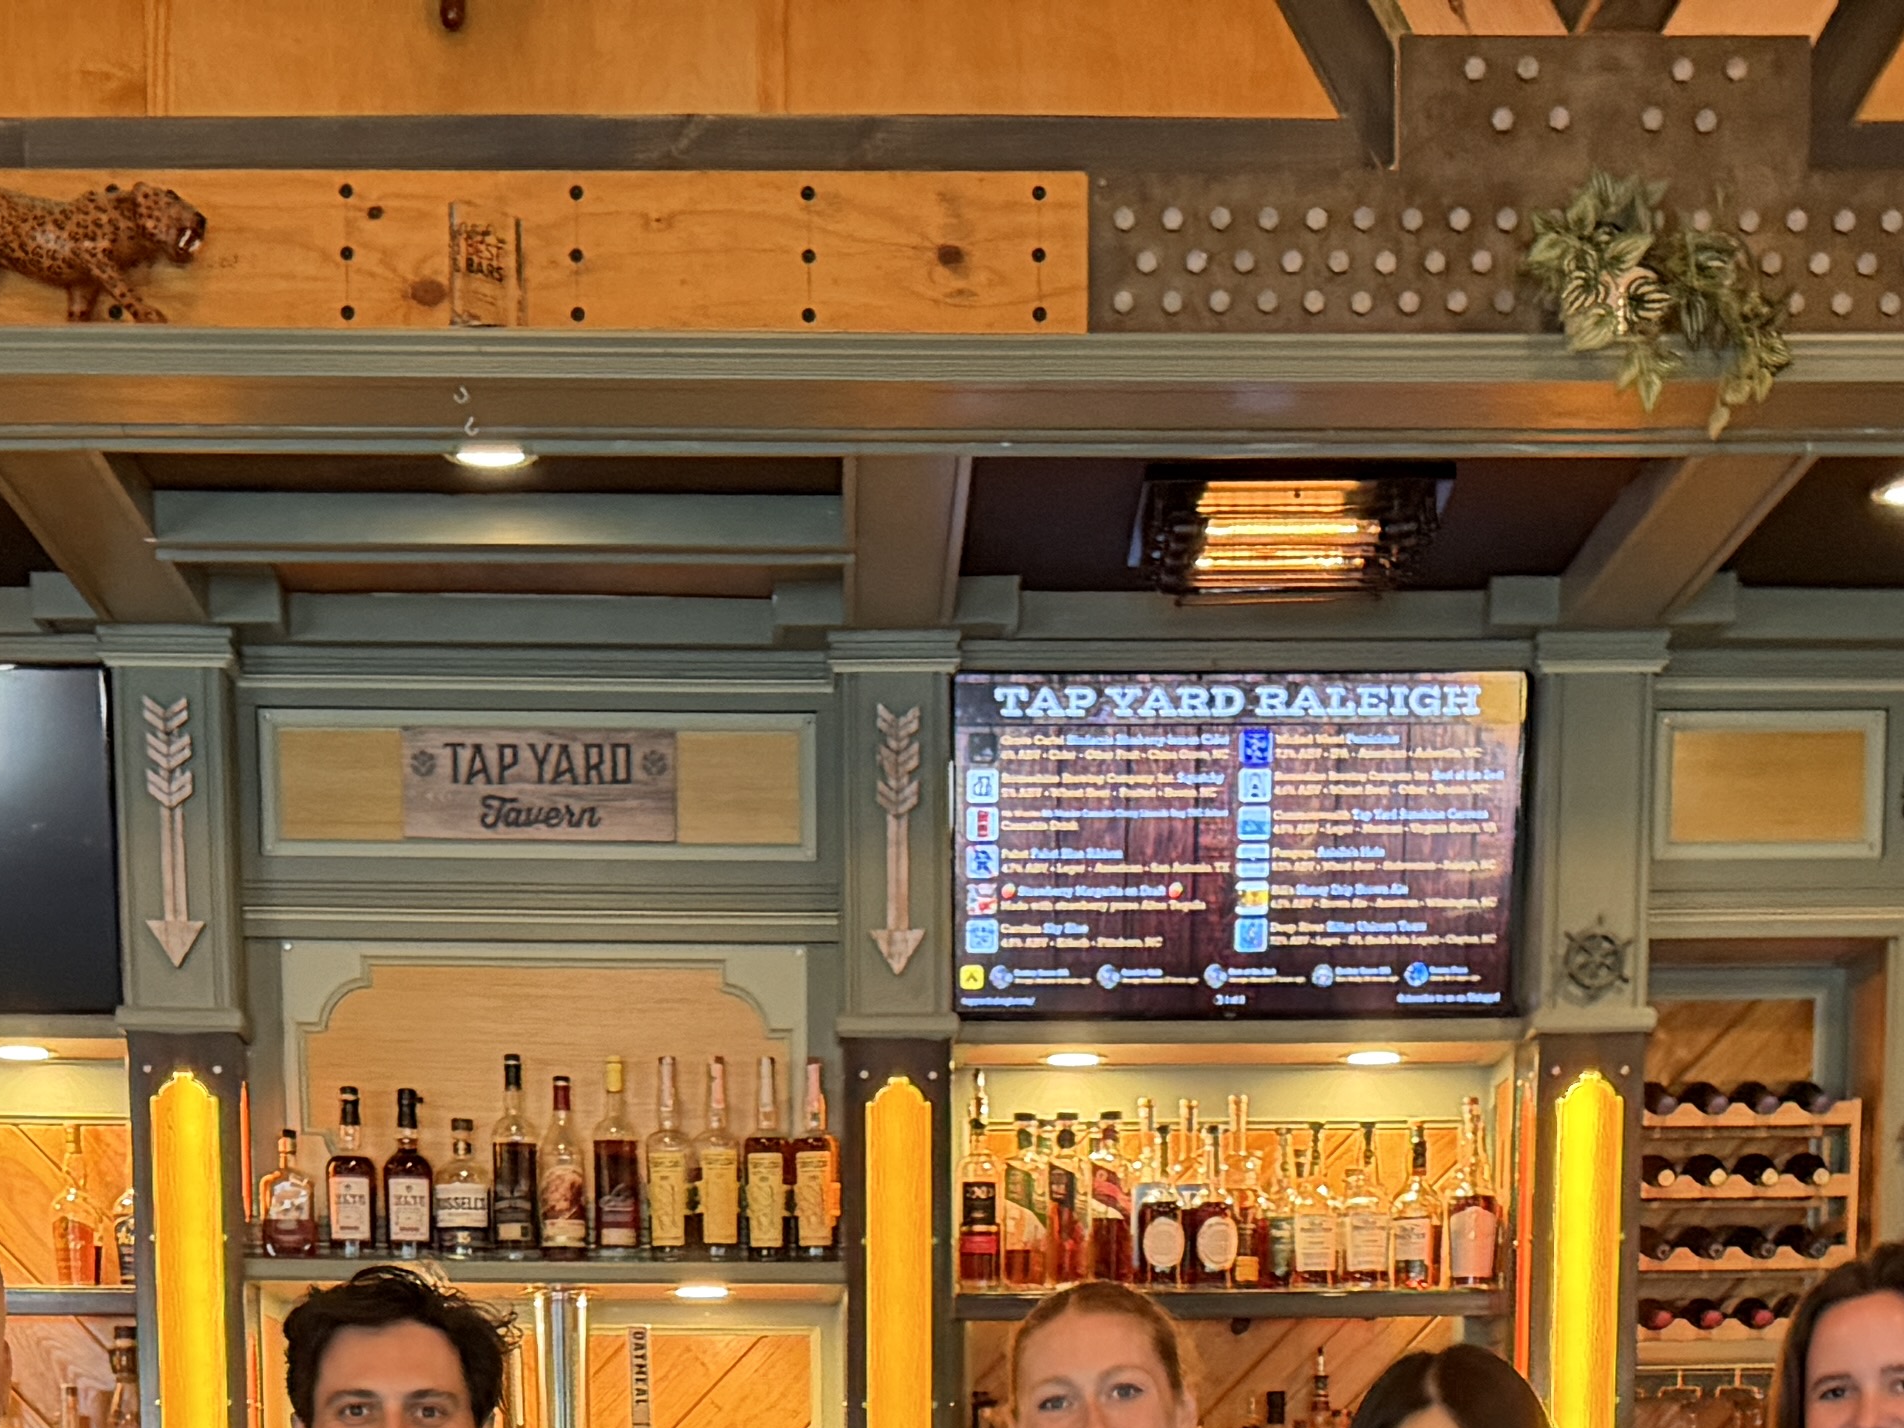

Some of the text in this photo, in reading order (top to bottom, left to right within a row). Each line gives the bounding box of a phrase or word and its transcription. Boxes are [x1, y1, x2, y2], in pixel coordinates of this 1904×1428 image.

[994, 684, 1482, 718] TAP YARD RALEIGH
[443, 742, 633, 786] TAP YARD
[480, 793, 602, 830] Tavern
